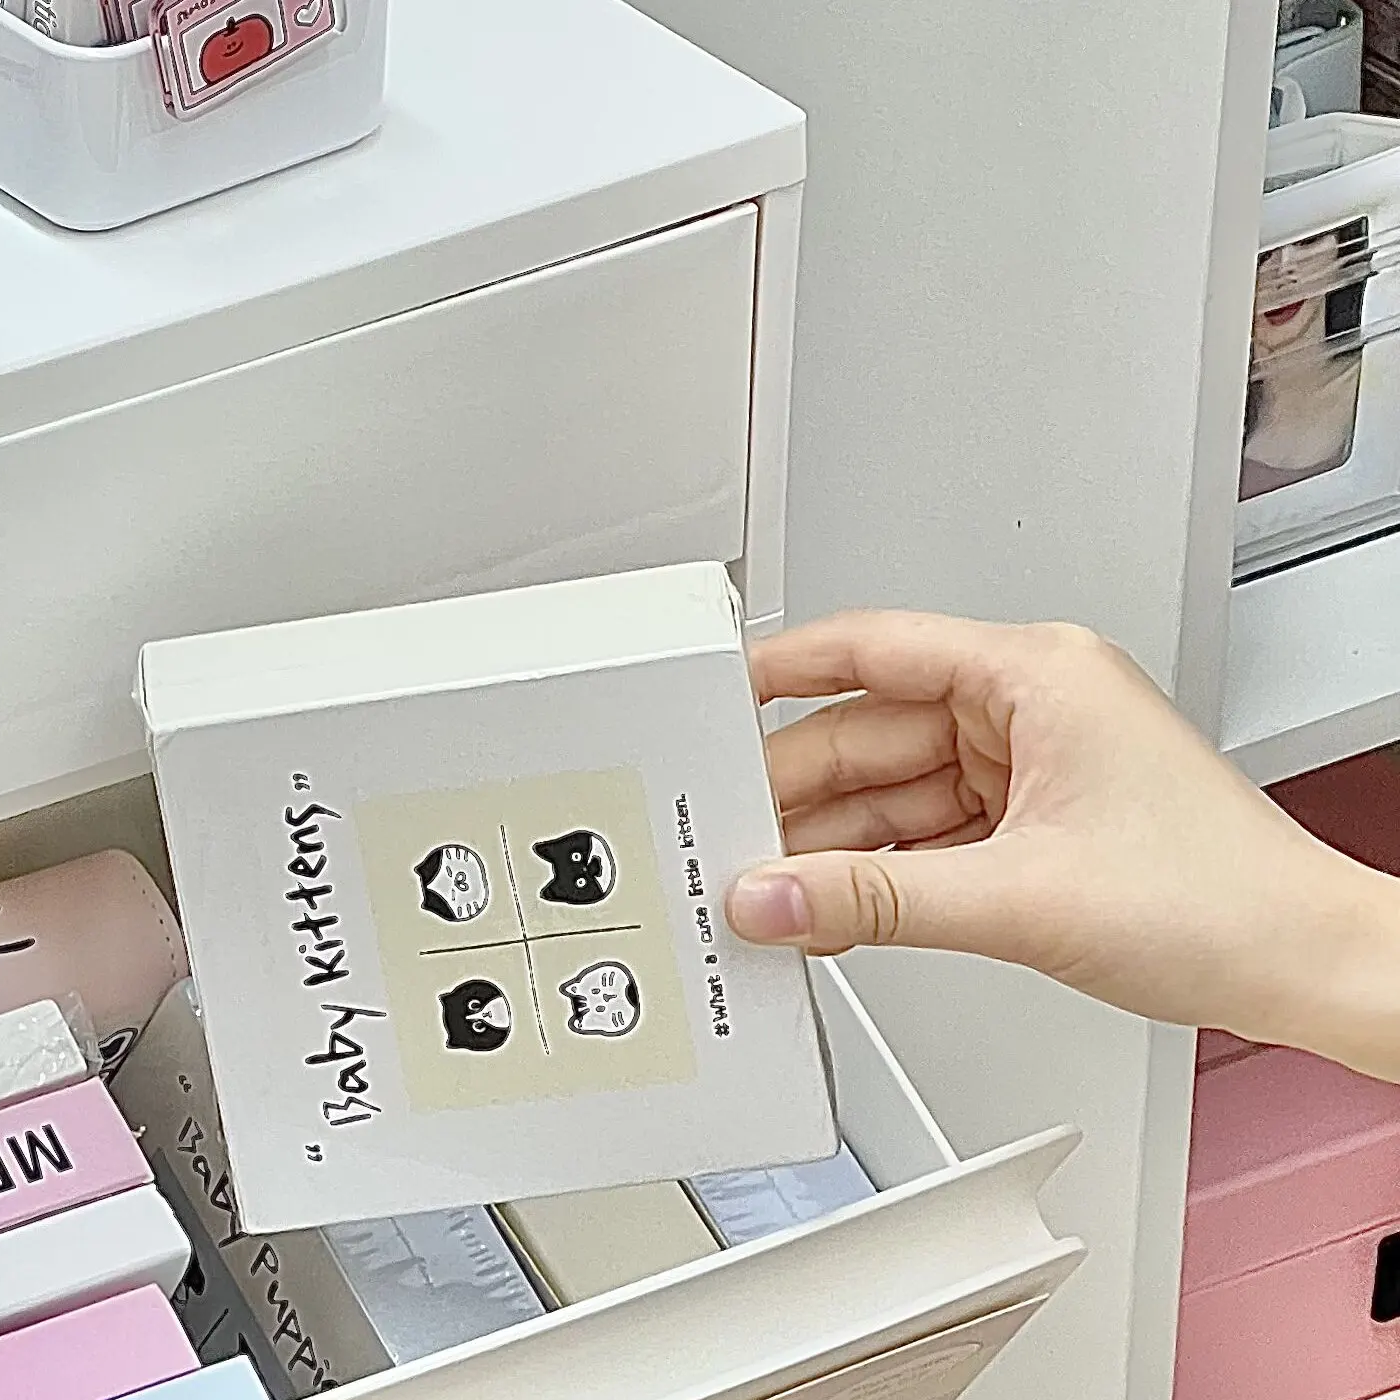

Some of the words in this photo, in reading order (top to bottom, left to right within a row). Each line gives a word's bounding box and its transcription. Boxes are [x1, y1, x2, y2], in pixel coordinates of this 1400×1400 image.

[675, 792, 695, 849] kitten.
[684, 857, 704, 897] little
[696, 906, 714, 943] cute
[704, 953, 718, 965] a
[707, 974, 730, 1038] #What
